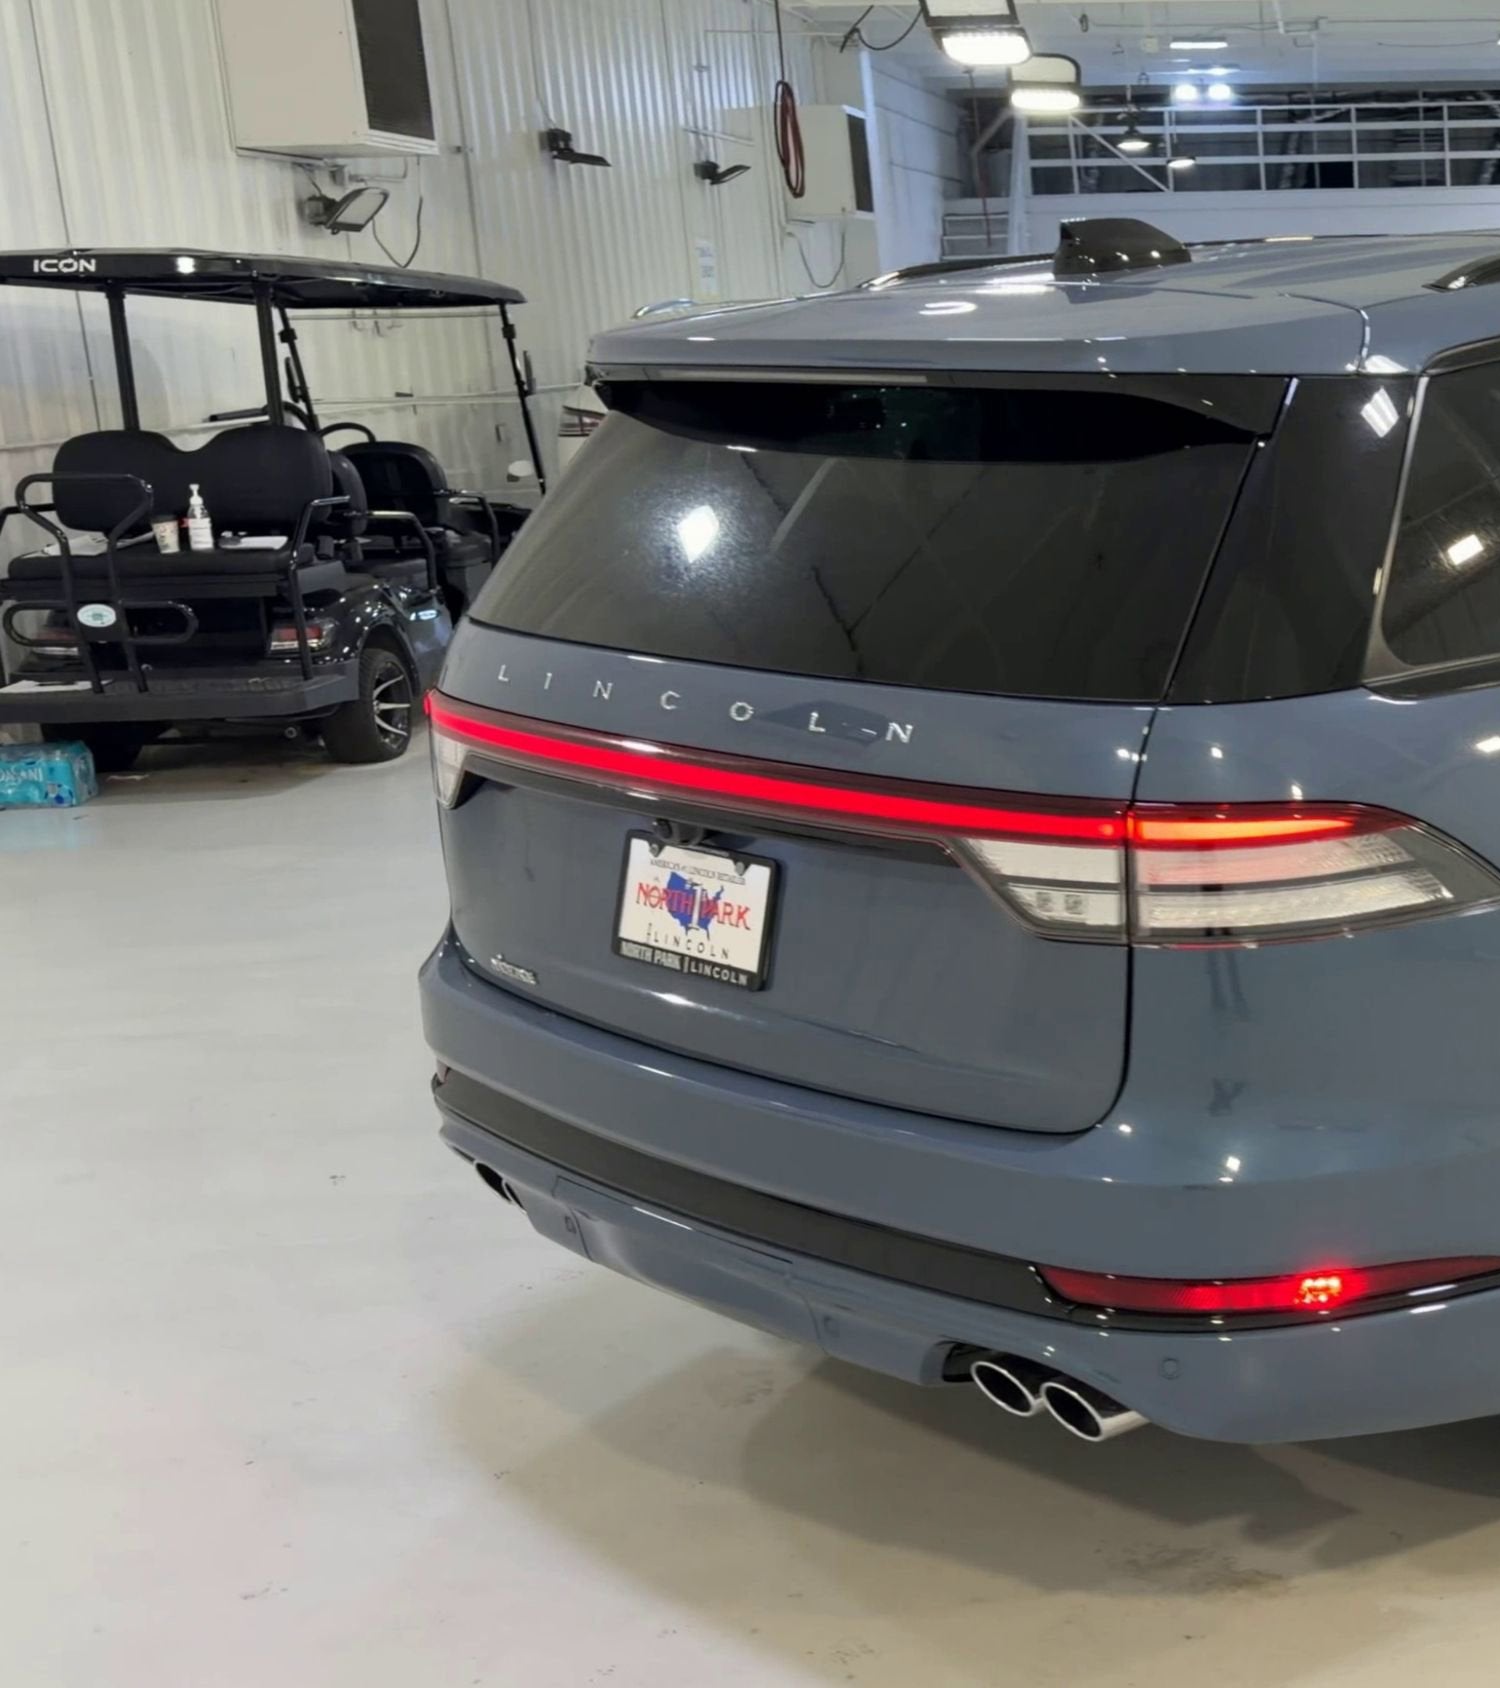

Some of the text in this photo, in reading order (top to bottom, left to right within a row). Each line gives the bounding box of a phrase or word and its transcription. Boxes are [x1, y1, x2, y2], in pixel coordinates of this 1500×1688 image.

[33, 258, 96, 273] ICON
[497, 663, 914, 744] LINCOLN
[635, 882, 752, 931] NORTH PARK
[653, 930, 730, 960] LINCOLN
[690, 960, 748, 986] LINCOLN
